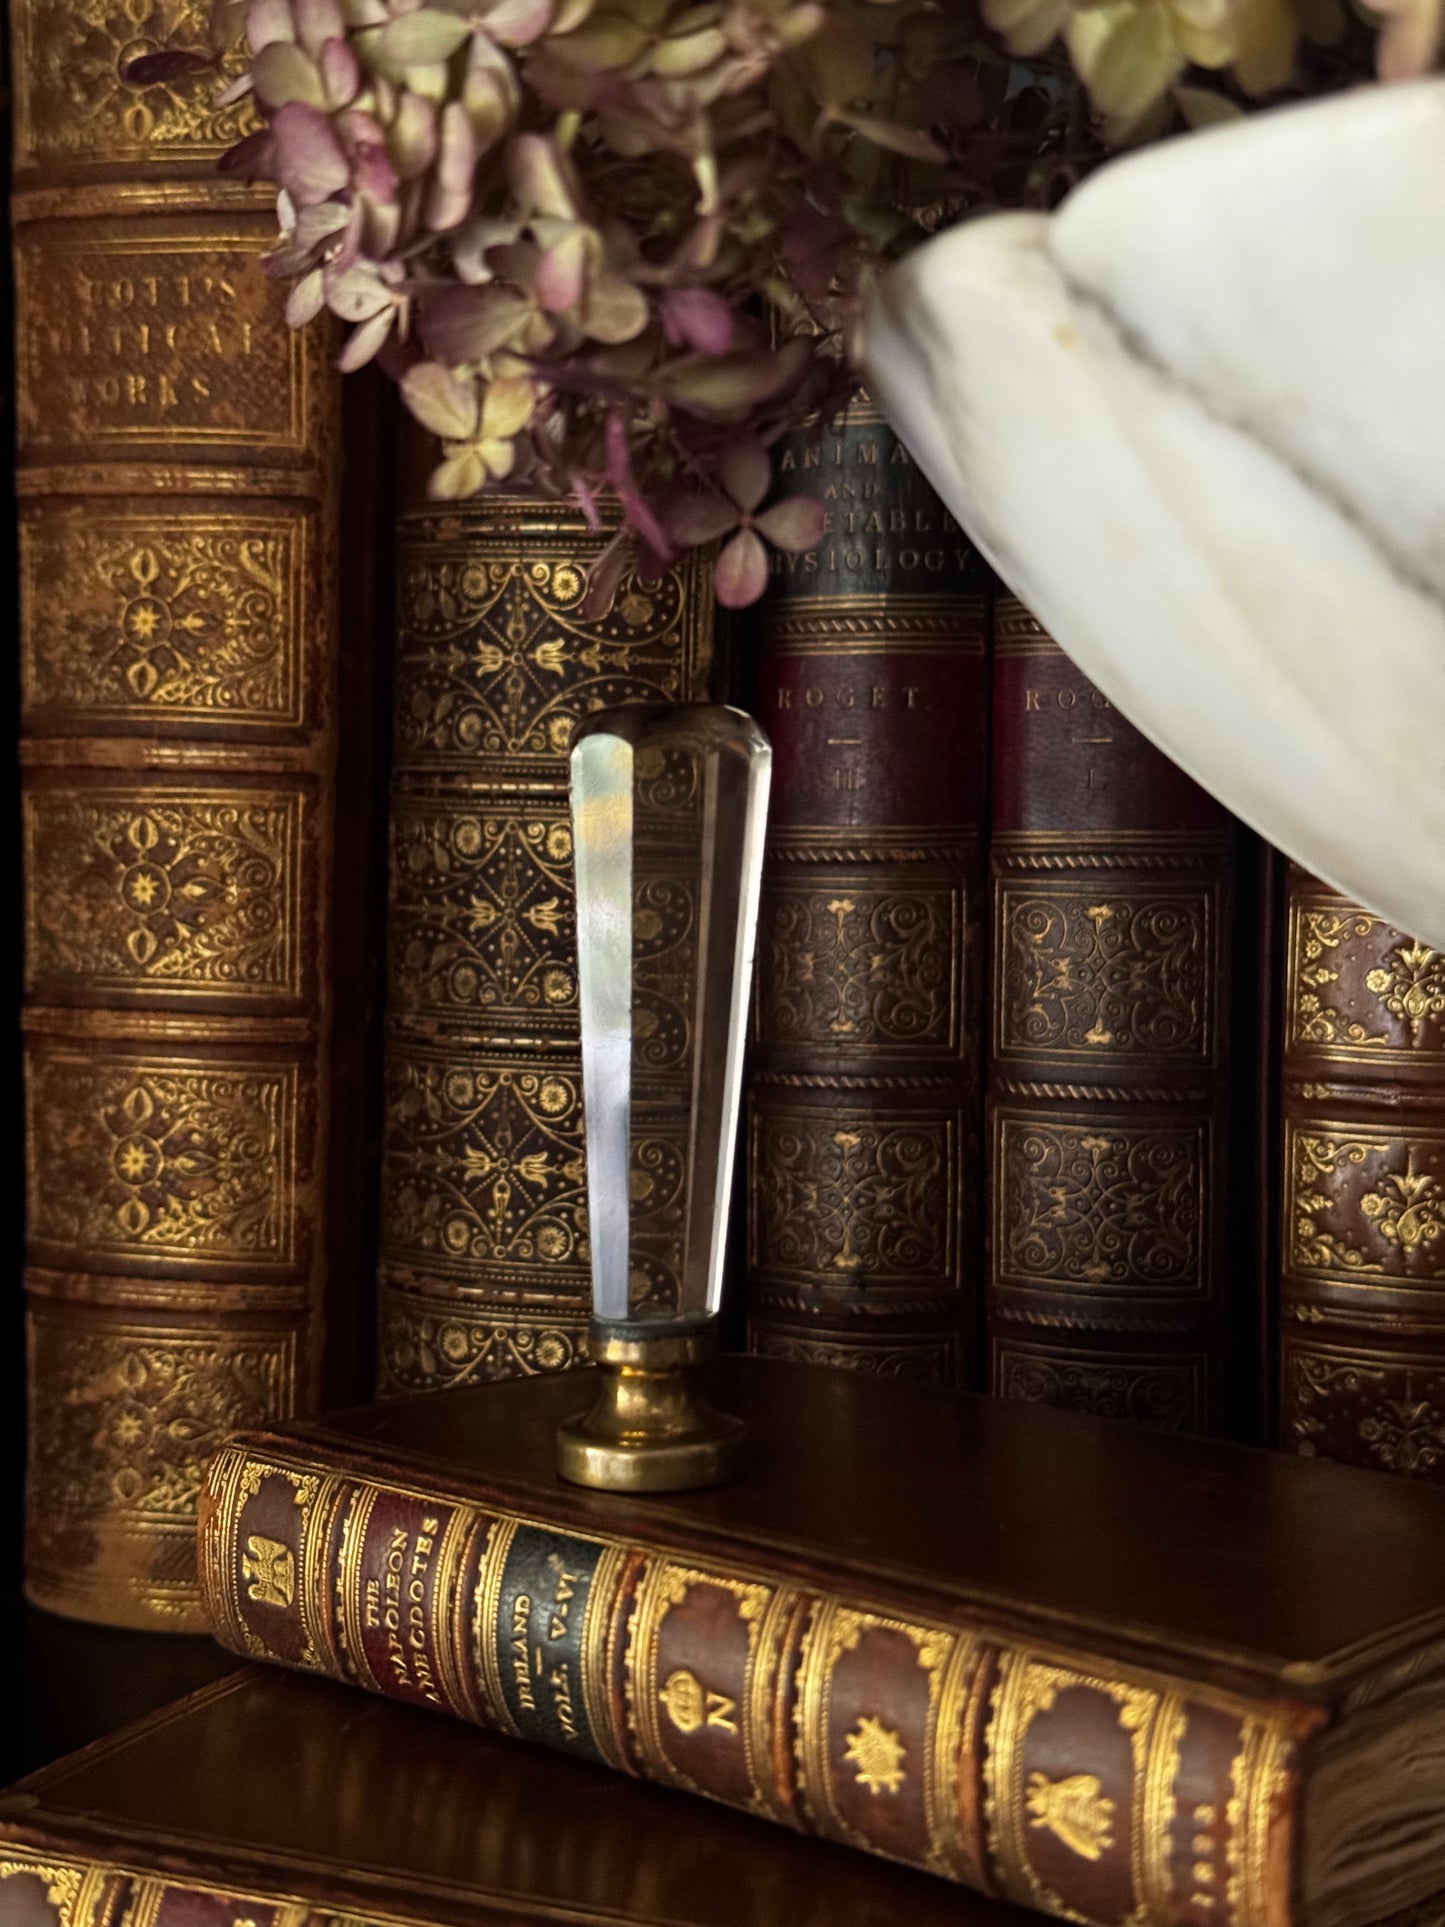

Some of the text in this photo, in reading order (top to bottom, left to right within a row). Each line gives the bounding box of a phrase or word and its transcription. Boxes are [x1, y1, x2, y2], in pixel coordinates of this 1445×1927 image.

[781, 442, 912, 471] ANIMA
[824, 482, 880, 500] AND
[823, 510, 957, 534] ETABLE
[772, 547, 976, 575] HYSIOLOGY.
[1024, 687, 1112, 711] ROG
[366, 1579, 380, 1627] THE
[384, 1527, 412, 1686] NAPOLEON
[408, 1516, 442, 1705] ANECDOTES
[511, 1595, 536, 1711] IRELAND
[706, 1689, 739, 1737] N
